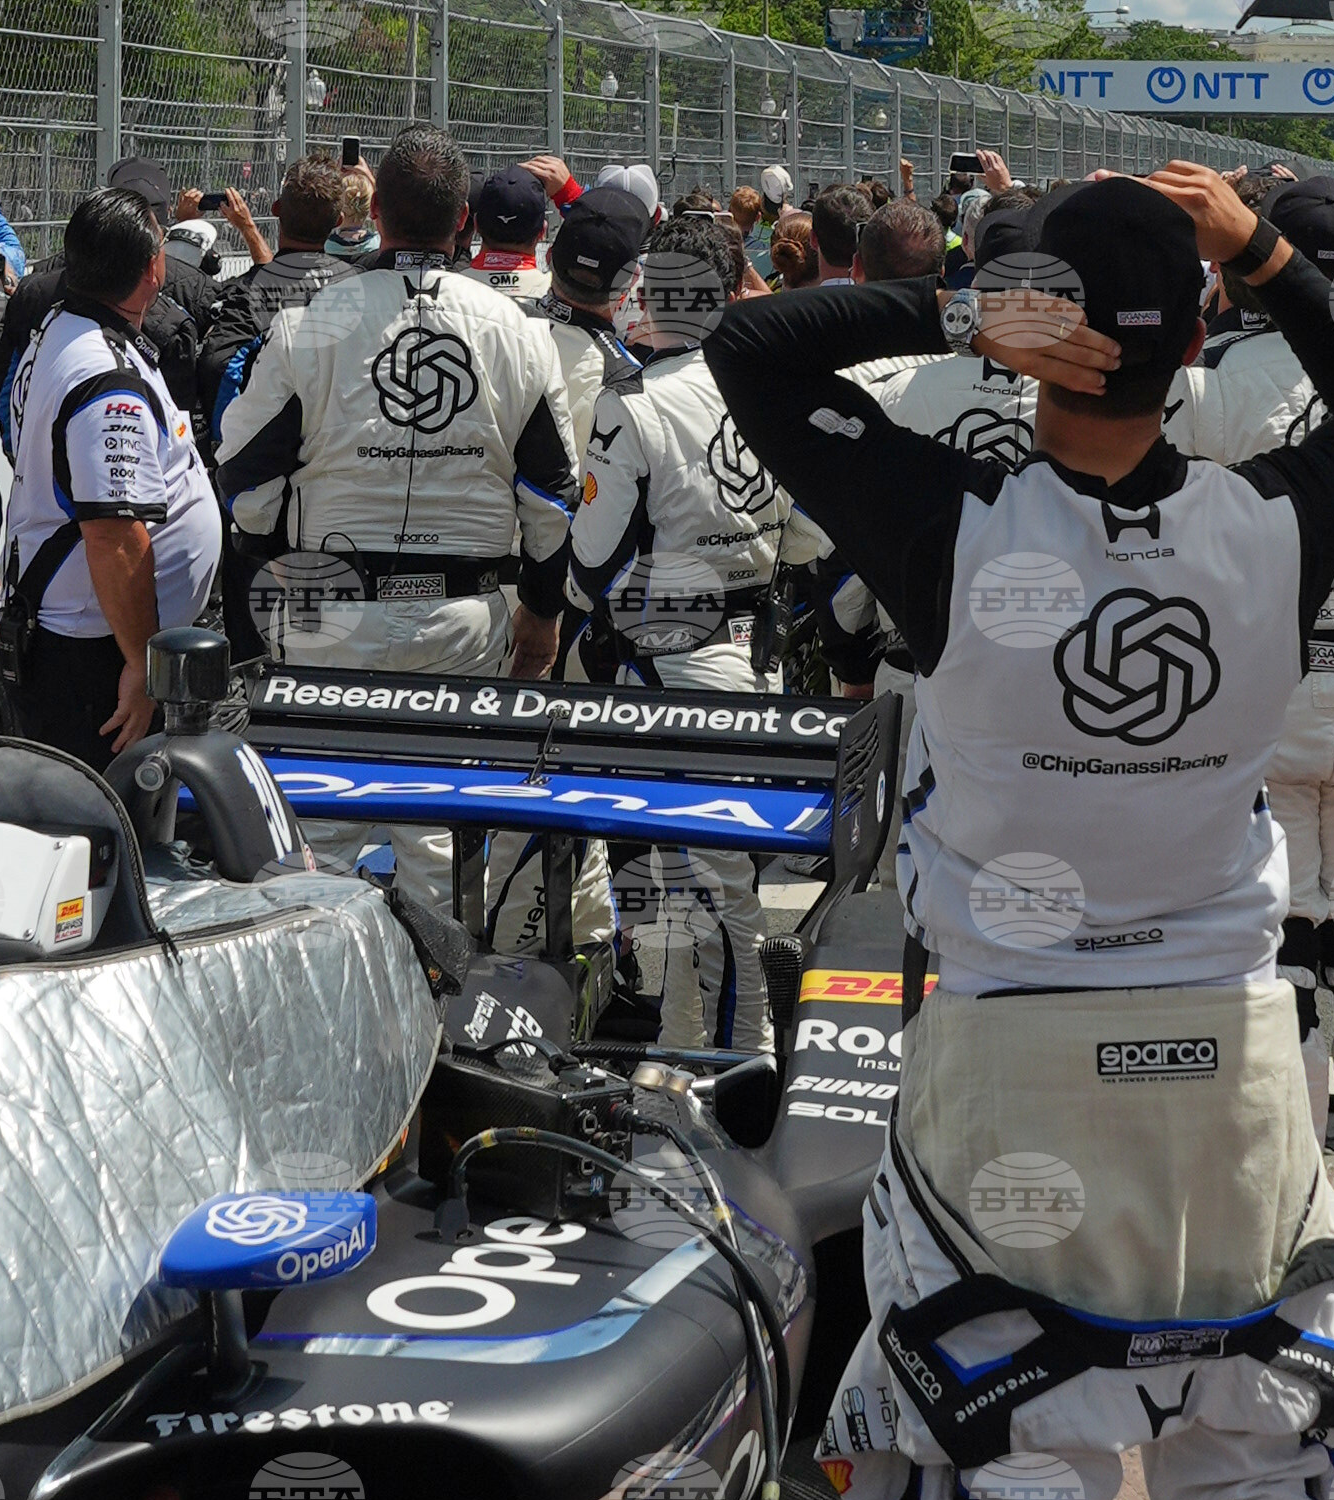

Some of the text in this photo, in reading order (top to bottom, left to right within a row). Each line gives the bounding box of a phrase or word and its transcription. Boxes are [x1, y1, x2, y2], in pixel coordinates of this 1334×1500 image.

[1039, 71, 1114, 98] NTT
[1193, 72, 1269, 100] NTT
[489, 273, 520, 286] OMP
[973, 384, 1020, 397] Honda
[104, 403, 143, 416] HRC
[102, 424, 145, 435] DHL
[120, 440, 141, 450] PNC
[357, 445, 485, 460] @ChipGanassiRacing
[104, 454, 141, 464] SUNOCO
[394, 532, 440, 544] sparco
[1105, 546, 1175, 562] Honda
[393, 577, 441, 590] GANASSI
[381, 587, 441, 597] RACING
[263, 676, 847, 737] Research & Deployment Co
[1021, 751, 1228, 777] @ChipGanassiRacing
[269, 772, 834, 833] OpenAI
[856, 1056, 901, 1072] Insu
[1099, 1038, 1216, 1075] sparco
[276, 1220, 367, 1283] OpenAI
[886, 1328, 942, 1405] sparco
[954, 1366, 1049, 1423] Firestone
[146, 1399, 452, 1440] Firestone
